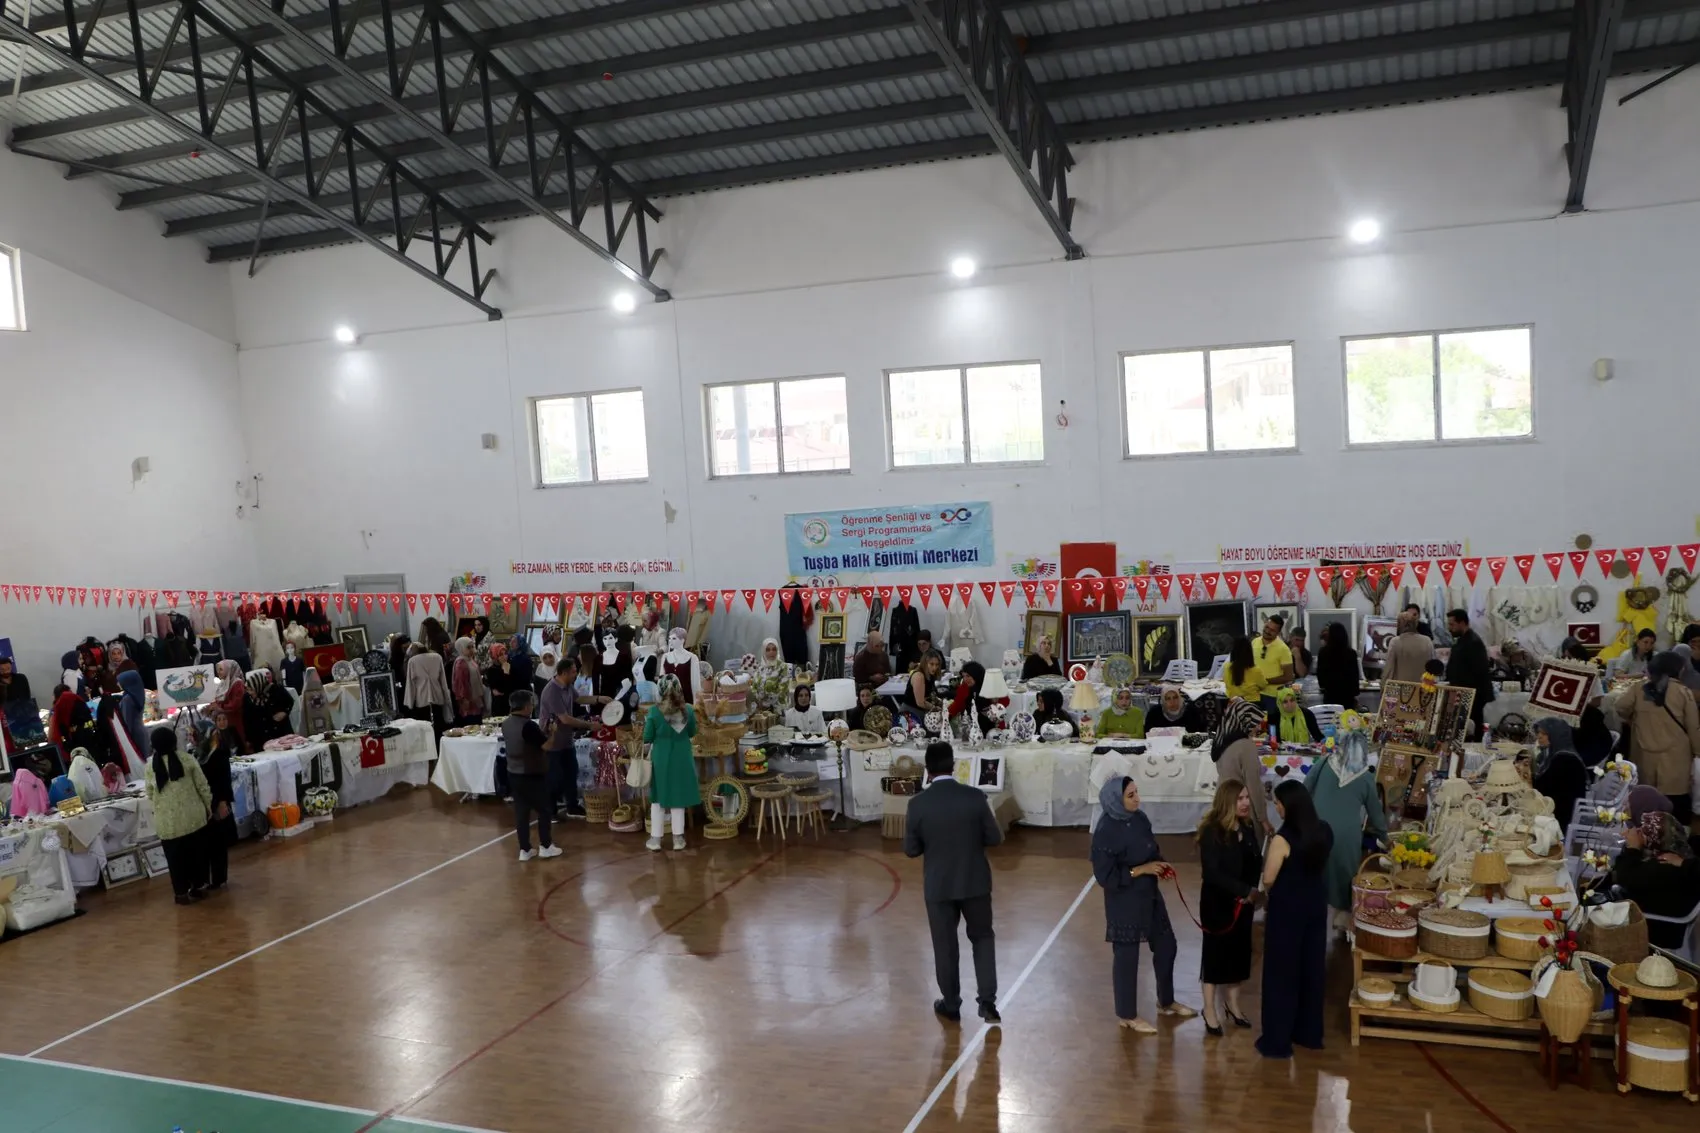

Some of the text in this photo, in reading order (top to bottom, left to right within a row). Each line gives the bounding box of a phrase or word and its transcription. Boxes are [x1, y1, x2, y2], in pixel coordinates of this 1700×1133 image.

[841, 512, 931, 526] Öğrenme Şenliği ve
[841, 528, 866, 538] Sergi
[868, 524, 932, 536] Programımıza
[860, 537, 915, 549] Hoşgeldiniz
[1221, 541, 1462, 561] HAYAT BOYU ÖĞRENME HAFTASI ETKİNLİKLERİMİZE HOŞ GELDİNİZ
[803, 547, 979, 572] Tuşba Halk Eğitimi Merkezi
[512, 563, 526, 574] HER
[555, 563, 569, 574] HER
[598, 562, 613, 573] HER
[613, 562, 629, 573] KES
